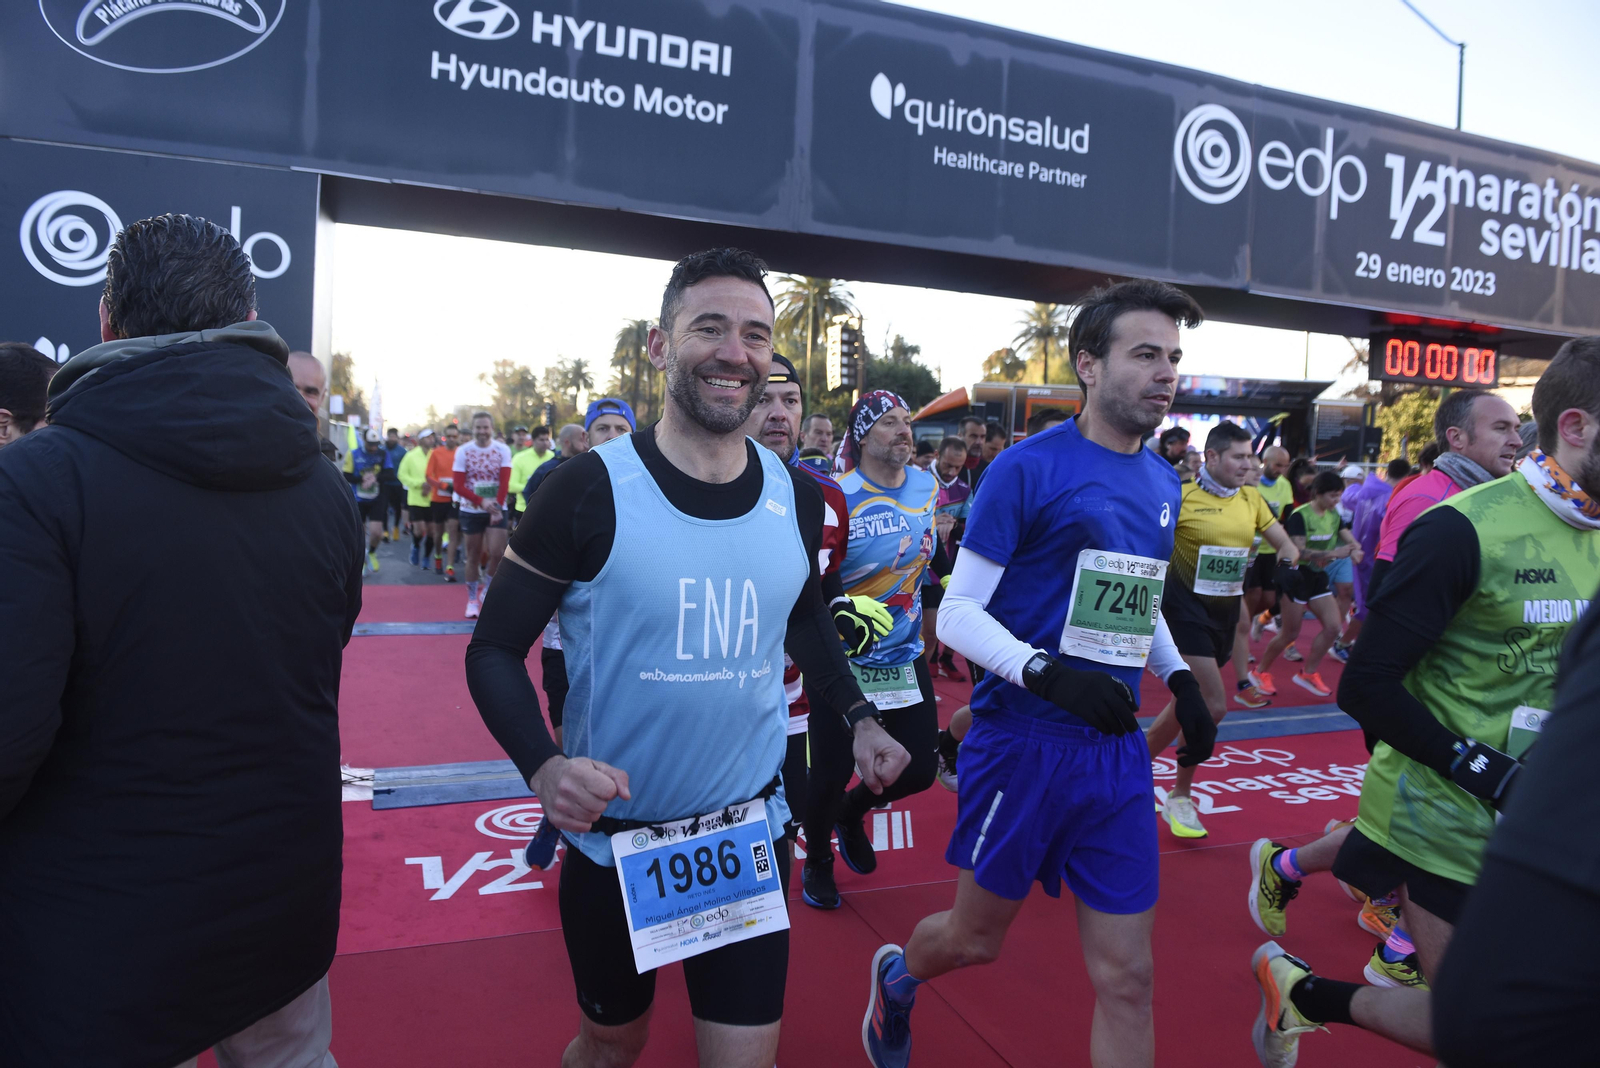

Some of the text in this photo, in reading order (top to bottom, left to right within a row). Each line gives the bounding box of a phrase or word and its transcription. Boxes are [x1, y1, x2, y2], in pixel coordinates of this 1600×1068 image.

[532, 11, 732, 77] HYUNDAI
[431, 51, 729, 125] Hyundauto Motor
[904, 98, 1090, 154] quirónsalud
[933, 145, 1087, 189] Healthcare Partner
[1258, 127, 1368, 220] edp
[1436, 164, 1600, 234] maratón
[1479, 219, 1600, 275] sevilla
[1354, 251, 1496, 297] 29 enero 2023
[864, 510, 894, 523] MARATÓN
[1207, 558, 1240, 574] 4954
[1514, 568, 1557, 584] HOKA
[1094, 579, 1149, 617] 7240
[1522, 599, 1572, 623] MEDIO
[676, 577, 759, 660] ENA
[1076, 619, 1102, 630] DANIEL
[1104, 623, 1132, 633] SANCHEZ
[639, 666, 735, 683] entrenamiento
[738, 671, 748, 690] y
[861, 667, 901, 684] 5299
[646, 839, 741, 899] 1986
[645, 909, 675, 924] Miguel
[676, 902, 702, 918] Ángel
[703, 894, 732, 911] Molina
[732, 884, 767, 904] Villegas
[705, 905, 729, 924] edp
[679, 935, 699, 948] HOKA
